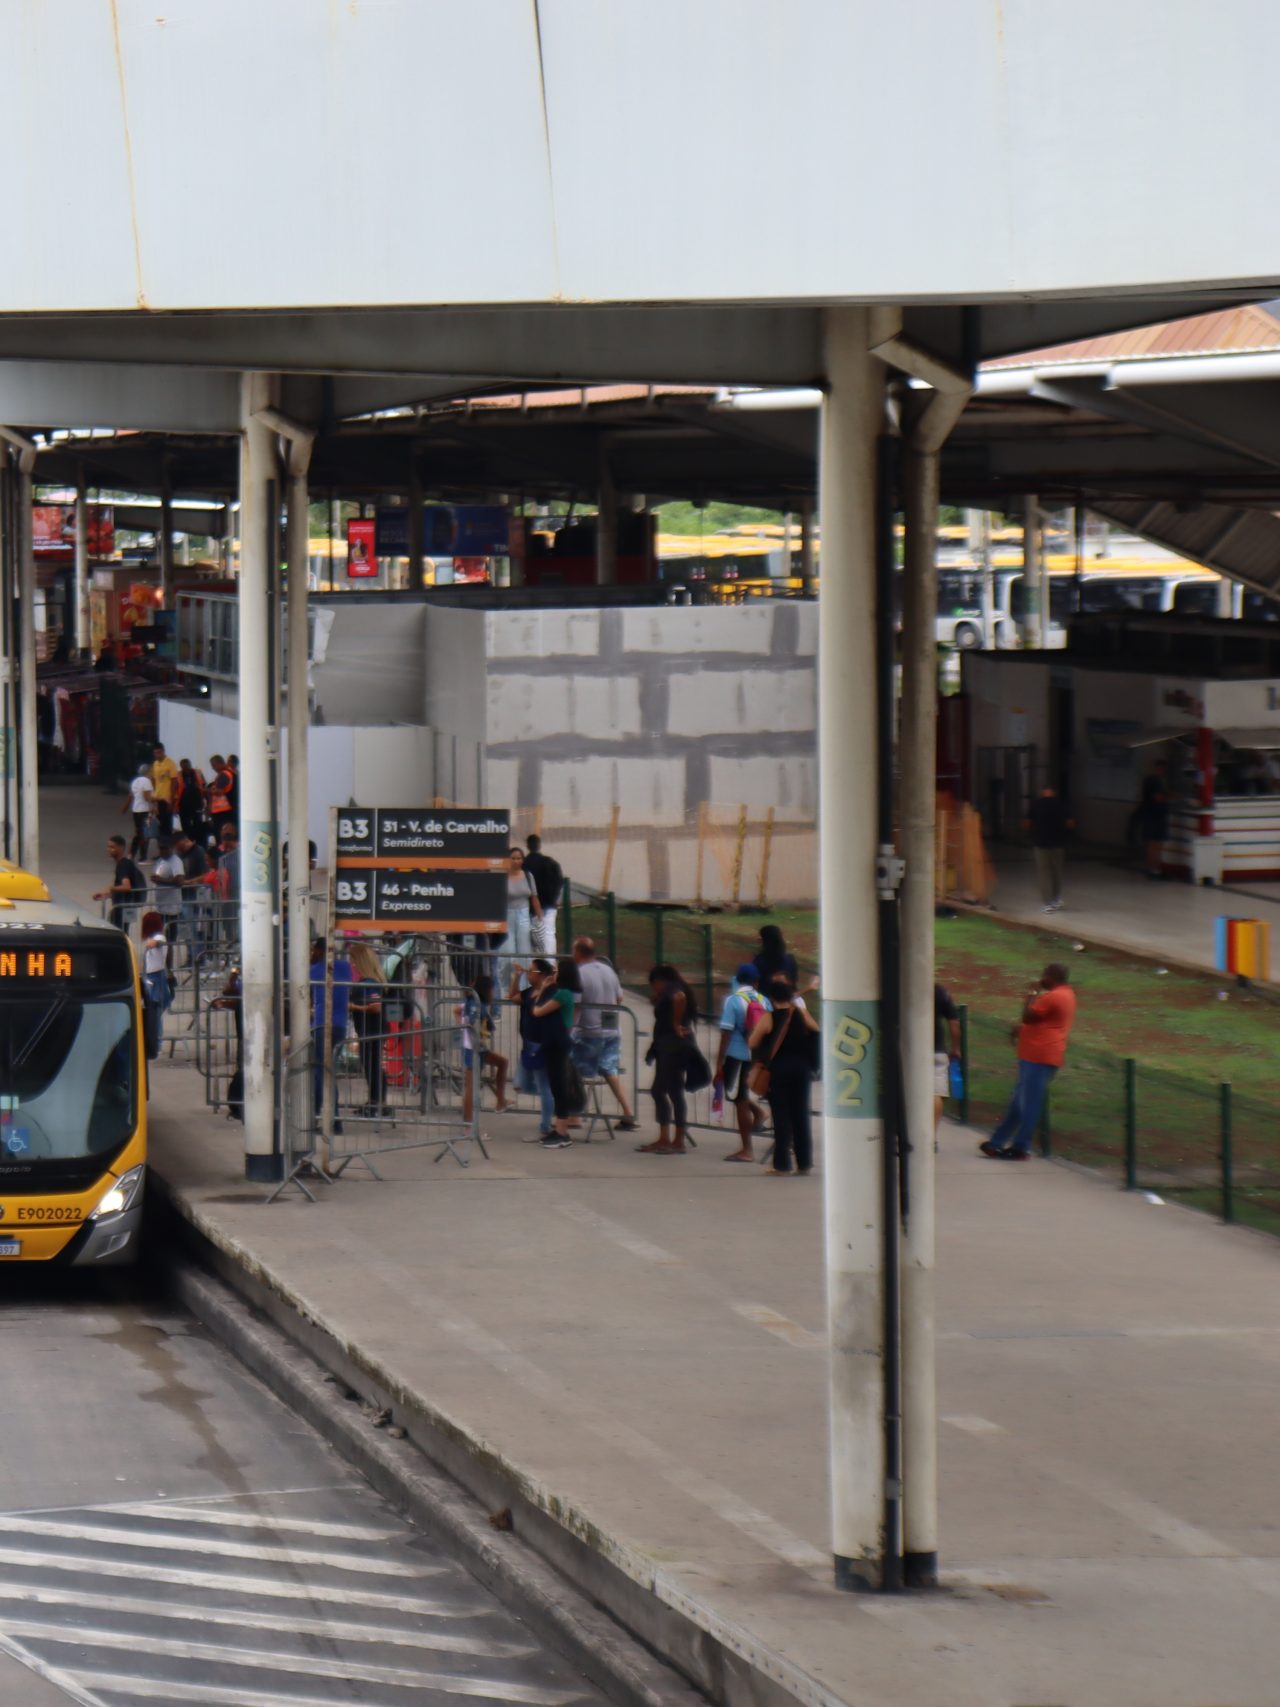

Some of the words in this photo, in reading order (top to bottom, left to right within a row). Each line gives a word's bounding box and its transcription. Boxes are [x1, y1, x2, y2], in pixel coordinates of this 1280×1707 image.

[338, 819, 369, 839] B3
[383, 820, 398, 833] 31
[409, 820, 421, 833] V.
[425, 820, 442, 833] de
[446, 820, 508, 834] Carvalho
[383, 838, 445, 848] Semidireto
[337, 881, 367, 901] B3
[381, 884, 400, 896] 46
[411, 883, 455, 896] Penha
[381, 900, 432, 912] Expresso
[17, 1207, 82, 1220] E902022
